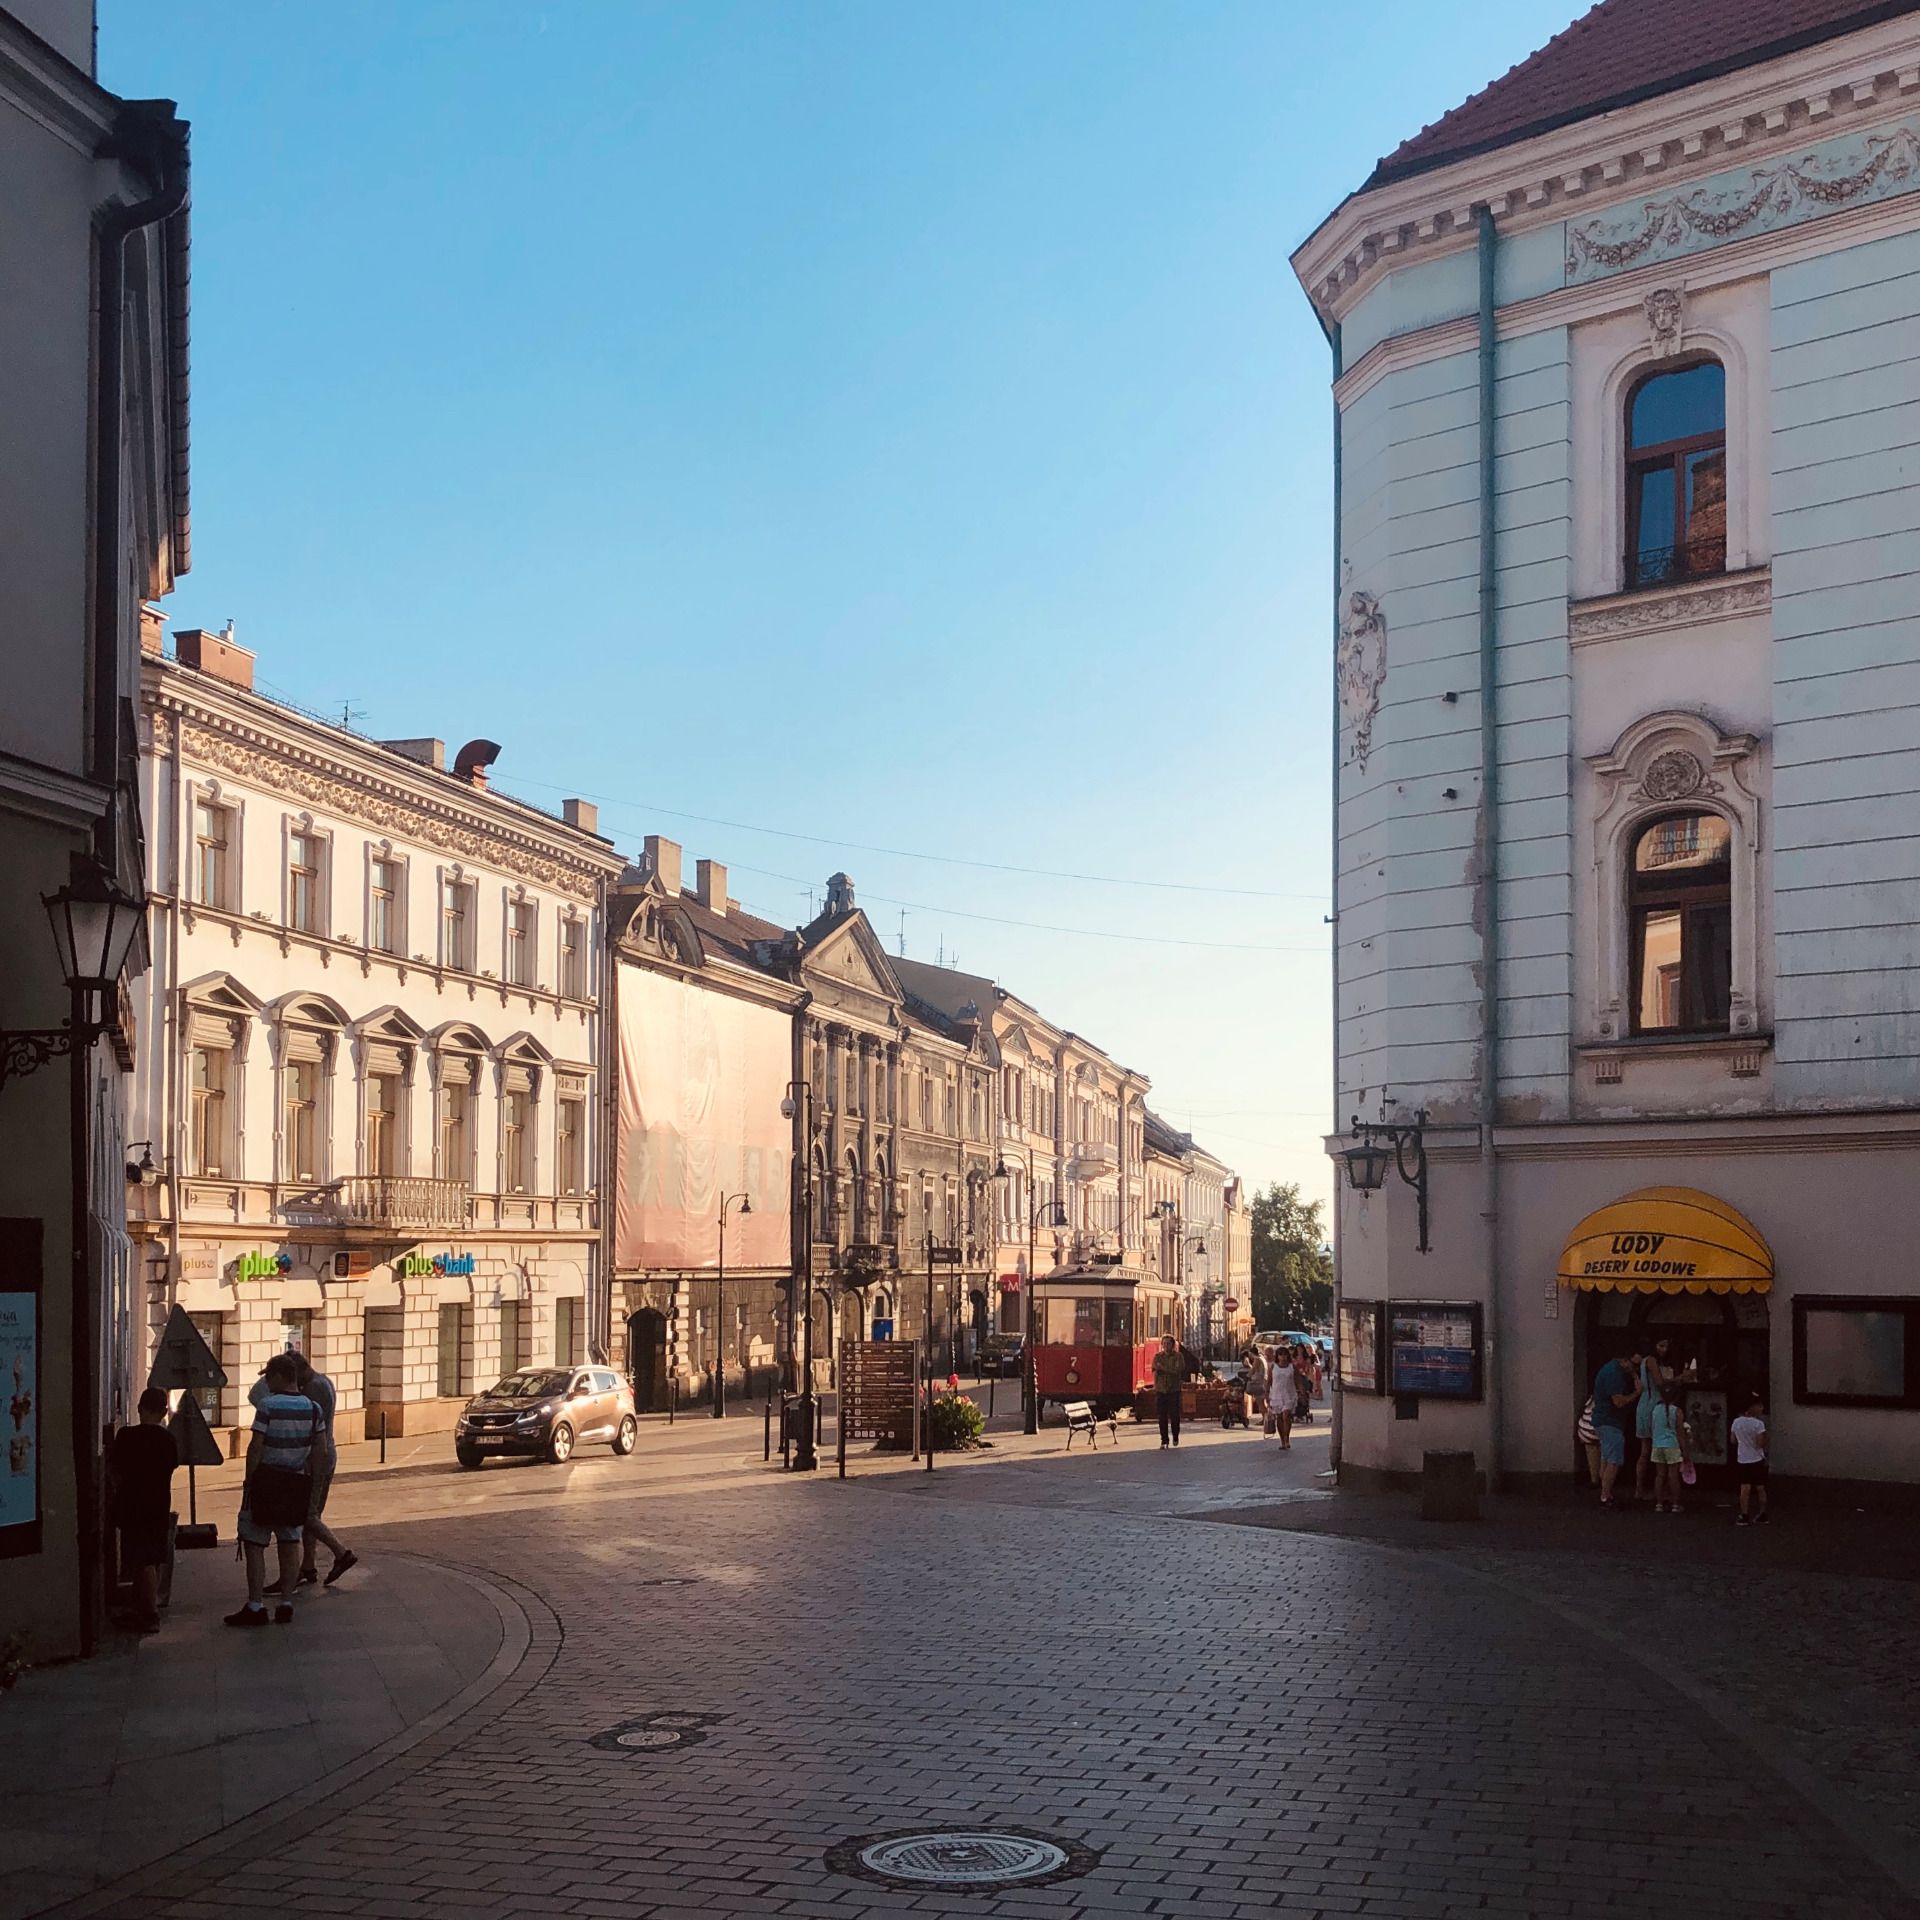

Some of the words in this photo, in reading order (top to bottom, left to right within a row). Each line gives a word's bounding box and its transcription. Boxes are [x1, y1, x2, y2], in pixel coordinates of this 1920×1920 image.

[1611, 1235, 1665, 1254] LODY
[184, 1257, 206, 1272] plus
[240, 1250, 280, 1282] plus
[405, 1251, 434, 1280] plus
[443, 1252, 476, 1276] bank
[1584, 1259, 1630, 1275] DESERY
[1634, 1260, 1697, 1276] LODOWE
[1070, 1356, 1078, 1367] 7
[206, 1394, 217, 1405] 5G
